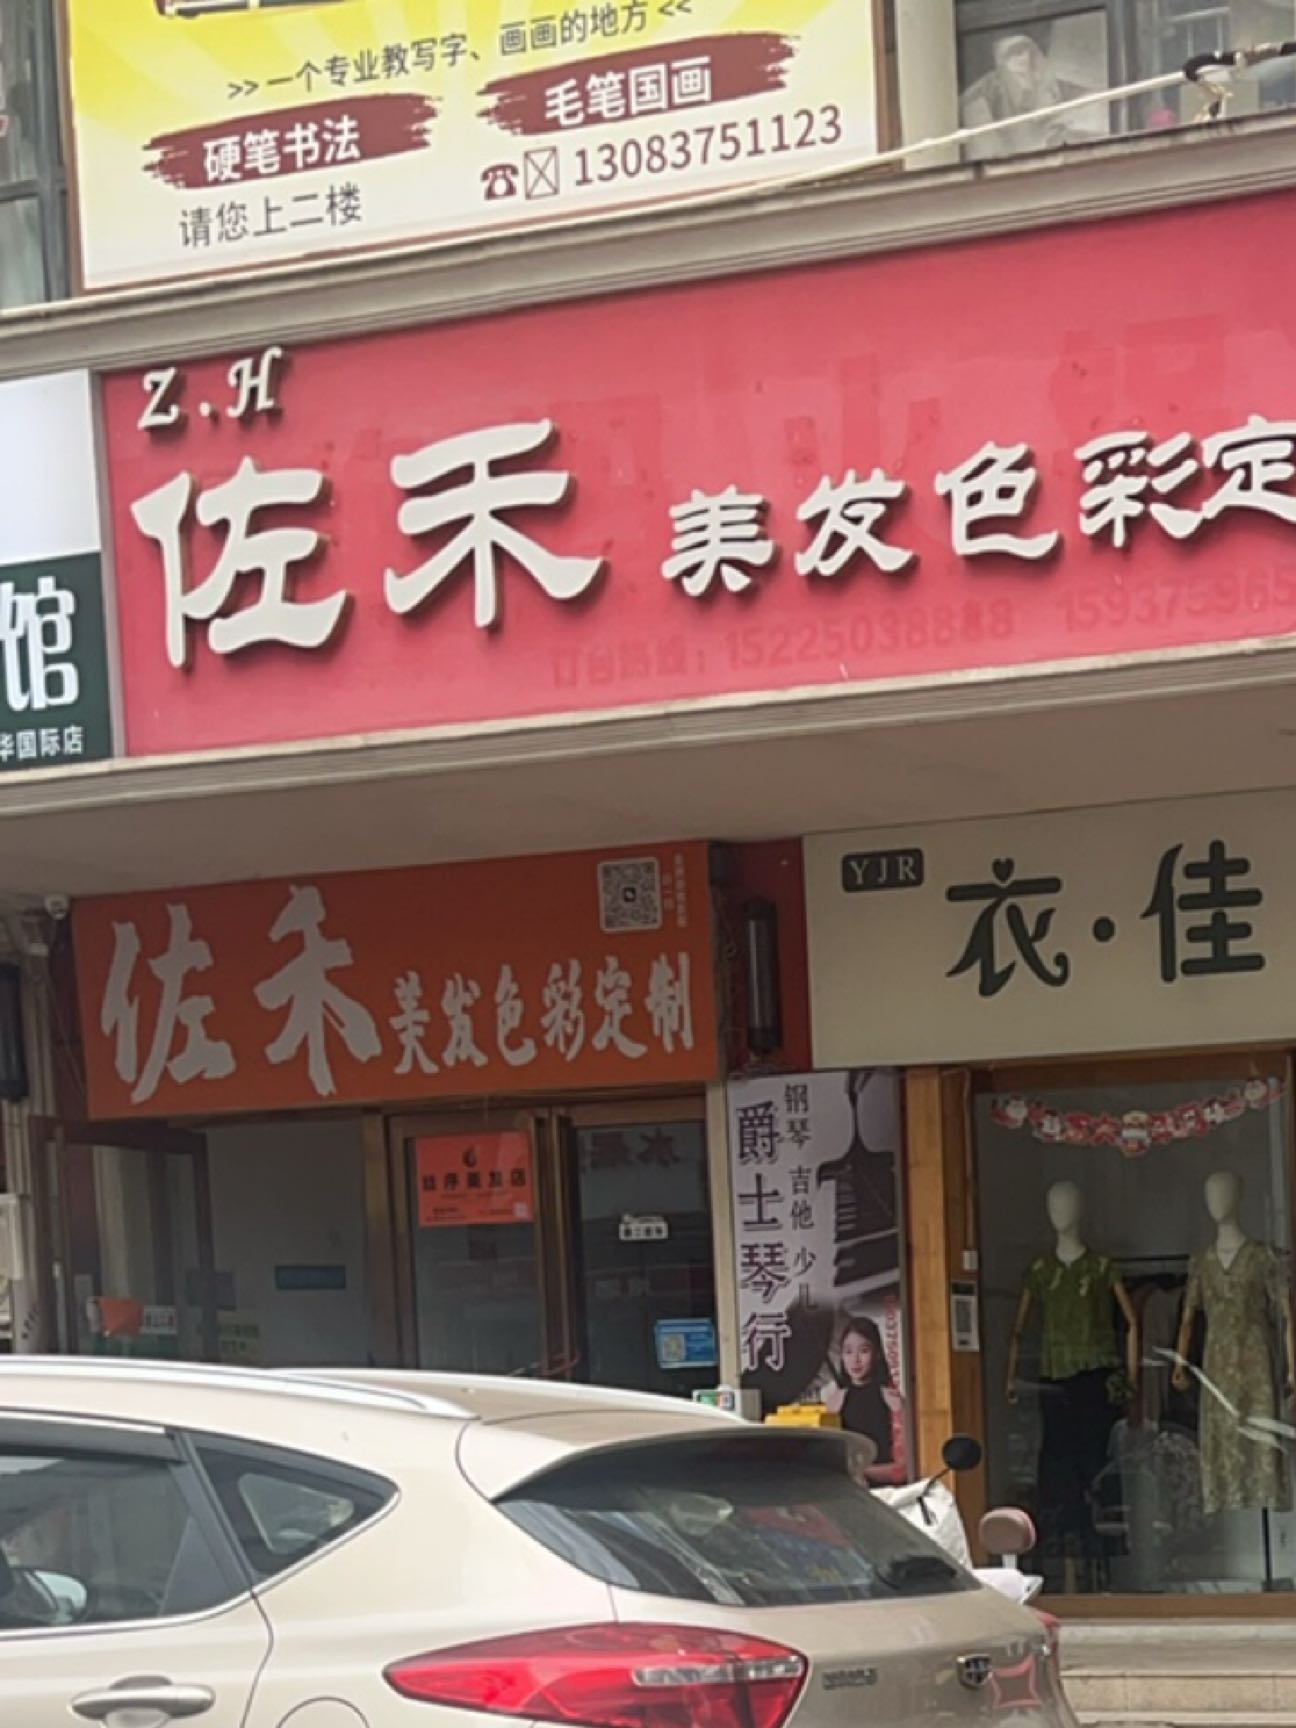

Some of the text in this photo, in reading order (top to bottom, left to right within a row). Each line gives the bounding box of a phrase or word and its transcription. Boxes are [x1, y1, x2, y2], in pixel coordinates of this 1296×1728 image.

[545, 57, 713, 125] 毛笔国画
[203, 117, 361, 181] 硬笔书法
[574, 105, 843, 187] 13083751123
[178, 184, 363, 248] 请您上二楼
[131, 419, 603, 668] 佐禾
[0, 576, 79, 711] 馆
[848, 854, 917, 885] YJR
[102, 885, 695, 1104] 佐禾 美发色彩定制
[736, 1100, 790, 1372] 爵士琴行
